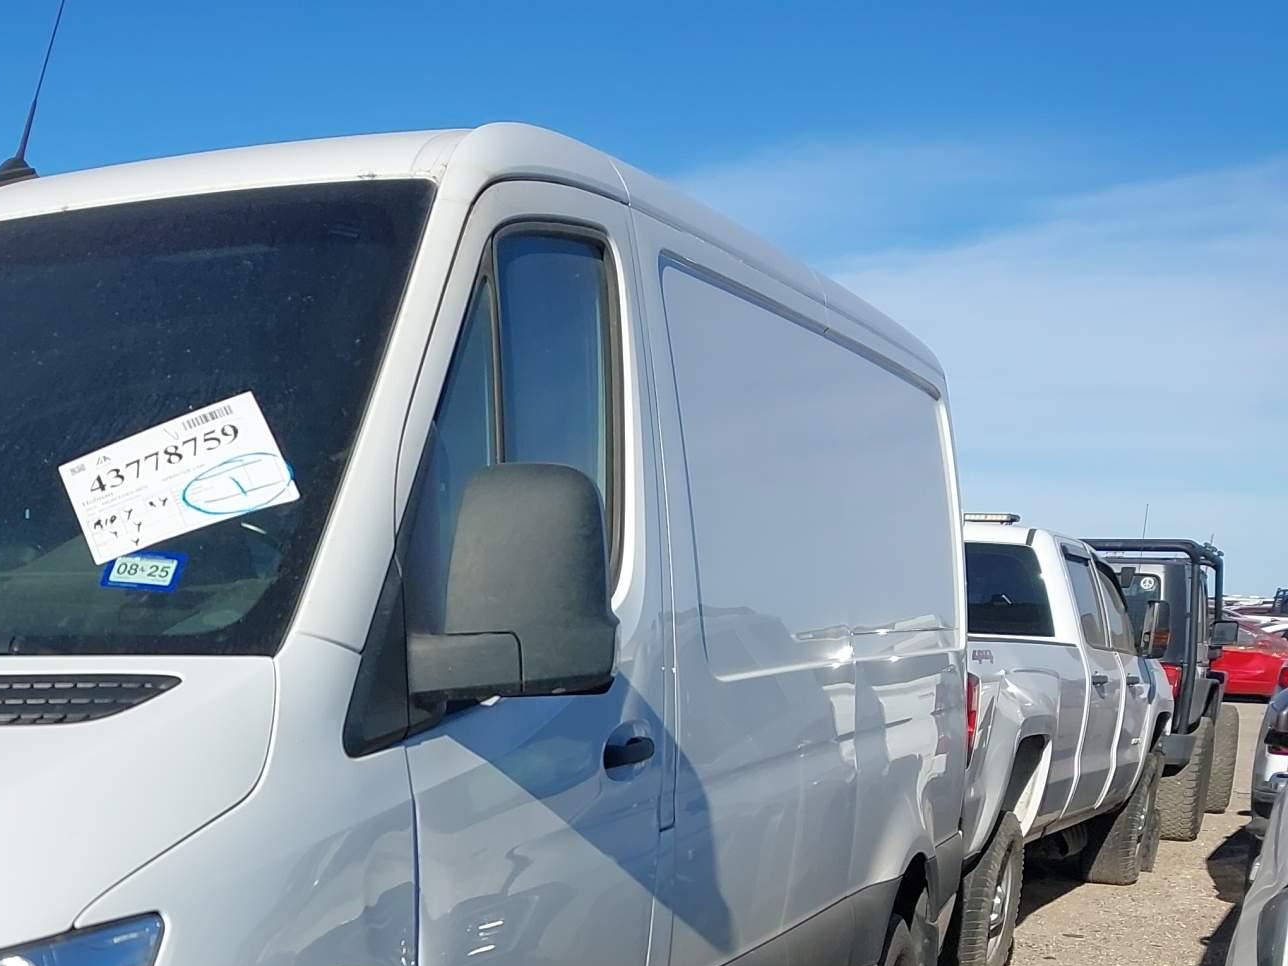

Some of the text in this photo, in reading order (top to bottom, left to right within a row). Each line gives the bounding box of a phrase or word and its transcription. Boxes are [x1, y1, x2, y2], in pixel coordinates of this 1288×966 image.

[88, 423, 240, 494] 43778759
[116, 562, 171, 578] 08 25
